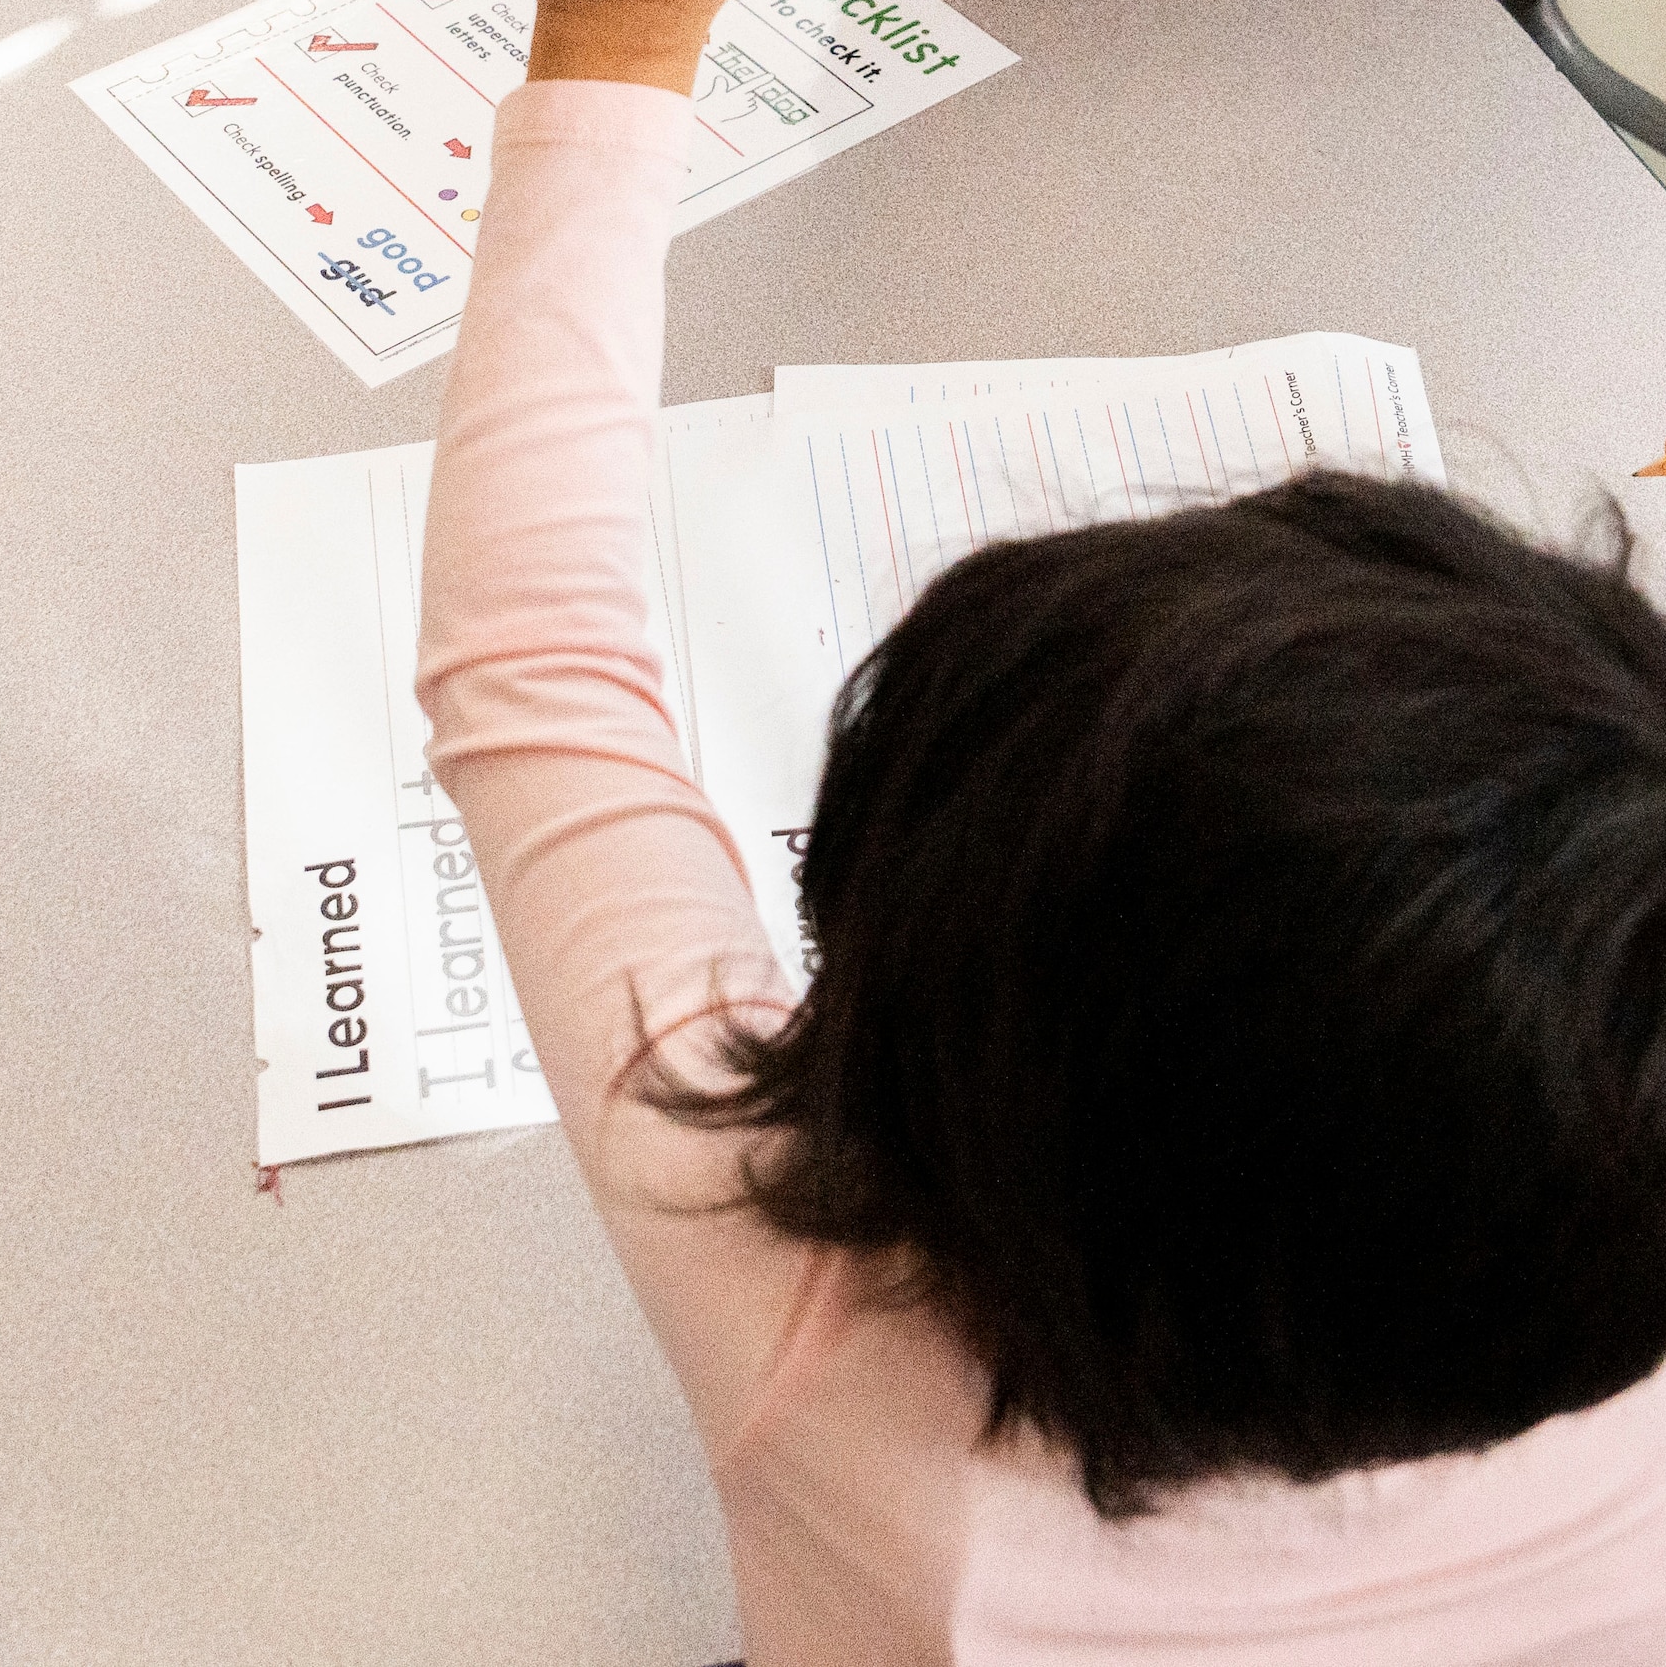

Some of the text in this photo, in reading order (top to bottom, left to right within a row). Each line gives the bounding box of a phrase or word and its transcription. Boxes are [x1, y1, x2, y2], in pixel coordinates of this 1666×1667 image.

[444, 21, 494, 63] letters.
[490, 2, 531, 35] Check
[795, 18, 862, 65] check
[855, 61, 884, 85] it.
[333, 71, 412, 142] punctuation.
[360, 61, 400, 95] Check
[713, 42, 811, 126] The dog
[223, 122, 307, 204] Check spelling.
[320, 258, 398, 309] gud
[356, 227, 451, 292] good
[1384, 362, 1399, 394] Corner
[1284, 370, 1317, 458] Teacher's Corner
[1389, 395, 1409, 439] Teacher's
[303, 857, 372, 1112] I Learned
[397, 816, 497, 1100] I learned
